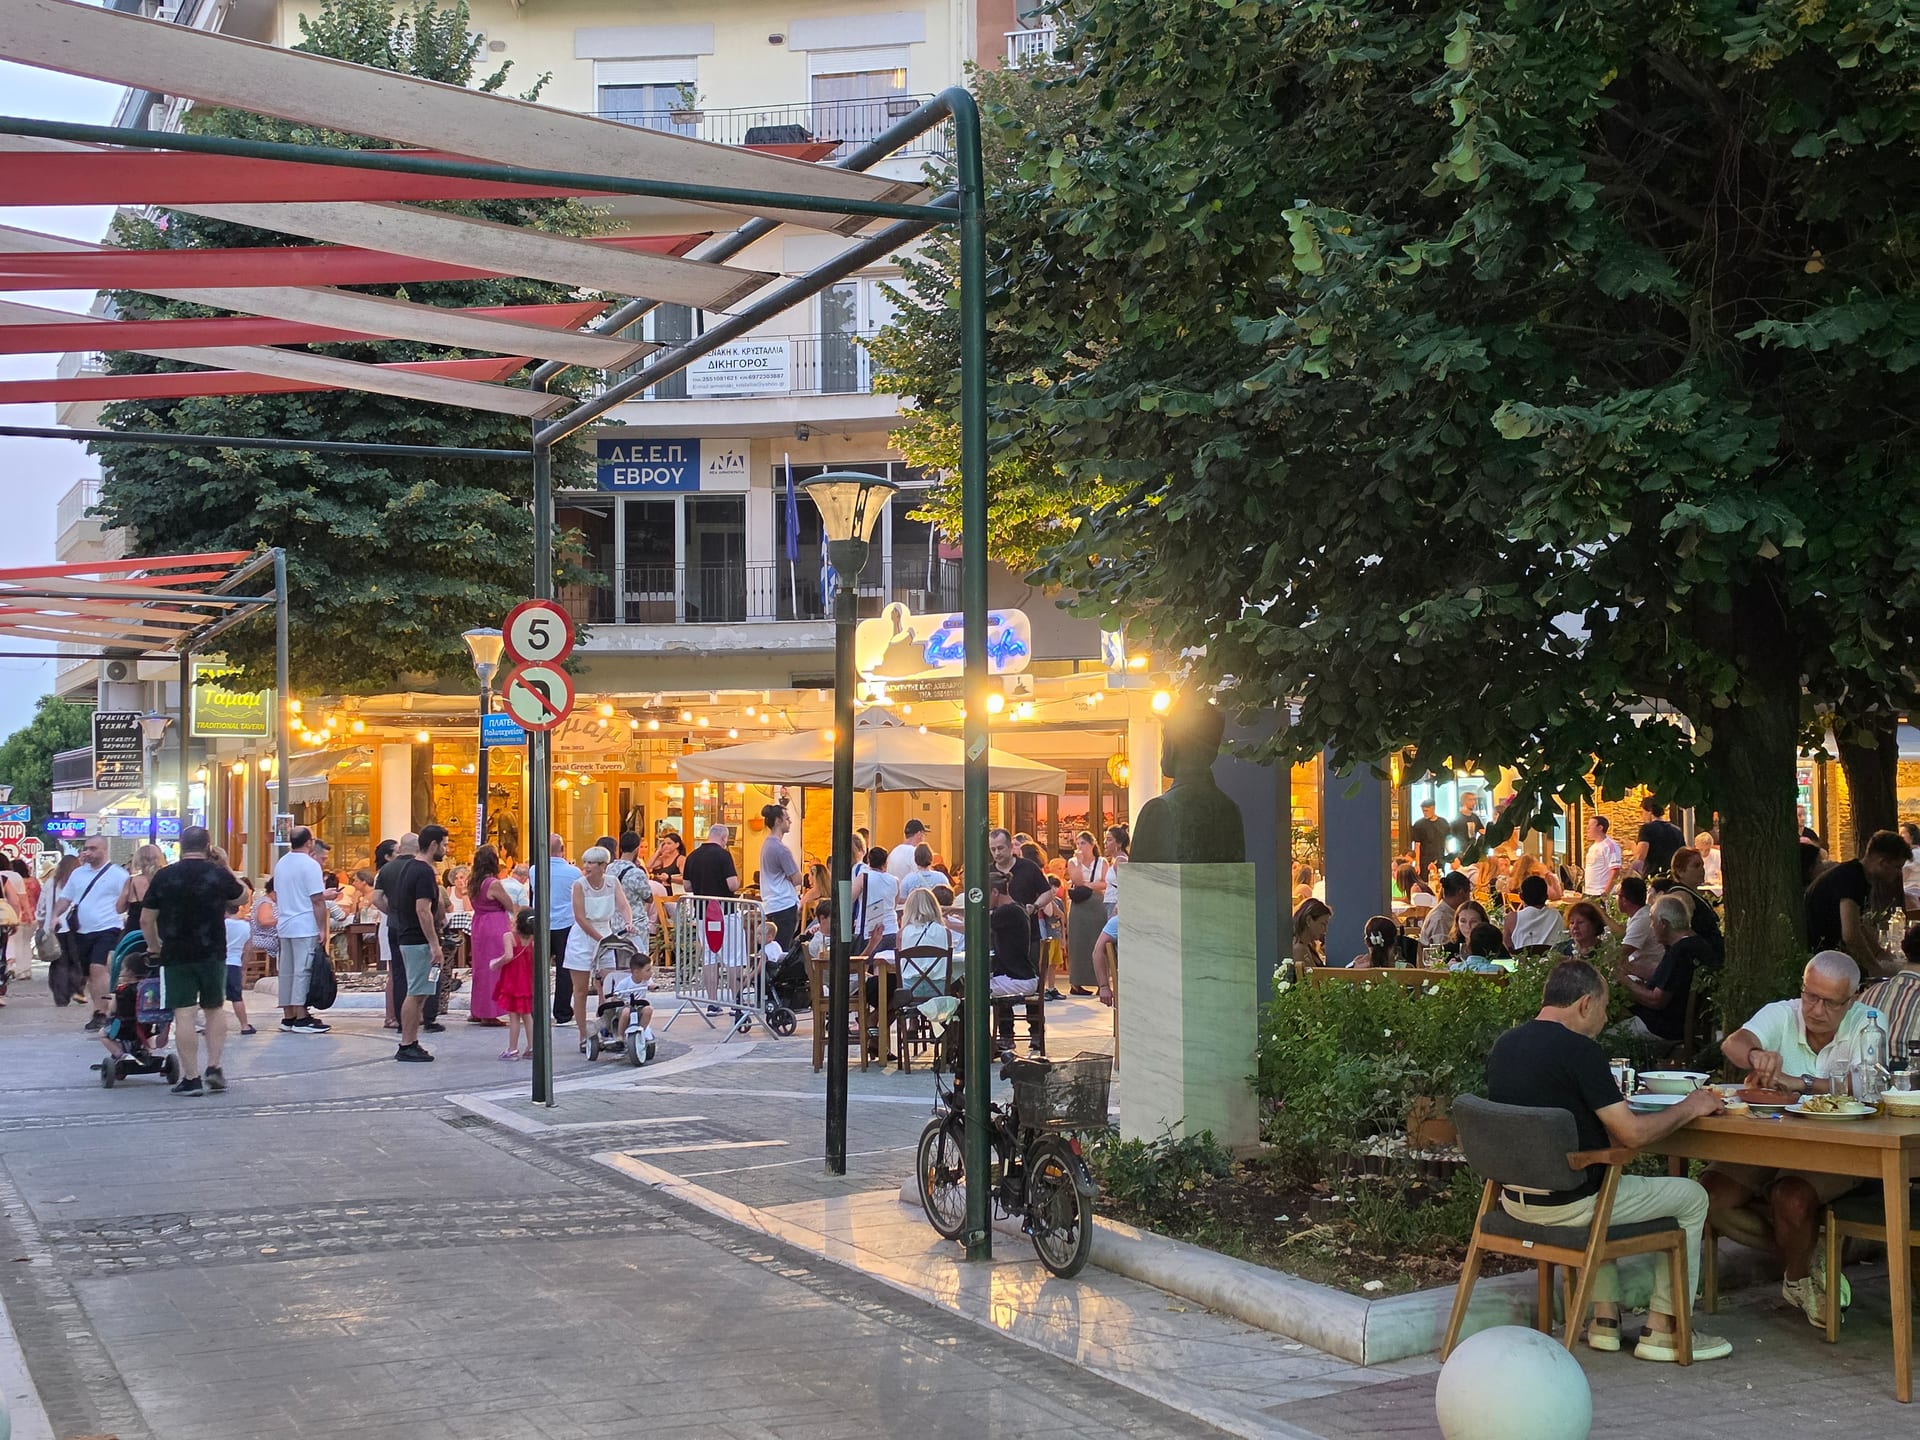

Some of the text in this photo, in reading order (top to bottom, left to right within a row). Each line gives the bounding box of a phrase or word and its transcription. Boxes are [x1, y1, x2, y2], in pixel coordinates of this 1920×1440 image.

[741, 346, 783, 355] ΚΡΥΣΤΑΛΛΙΑ
[708, 358, 768, 369] ΔΙΚΗΓΟΡΟΣ
[611, 445, 688, 463] Δ.Ε.Ε.Π.
[613, 467, 685, 485] ΕΒΡΟΥ
[527, 619, 549, 650] 5
[196, 722, 239, 730] TRADITIONAL
[0, 824, 23, 839] STOP
[21, 842, 42, 854] STOP
